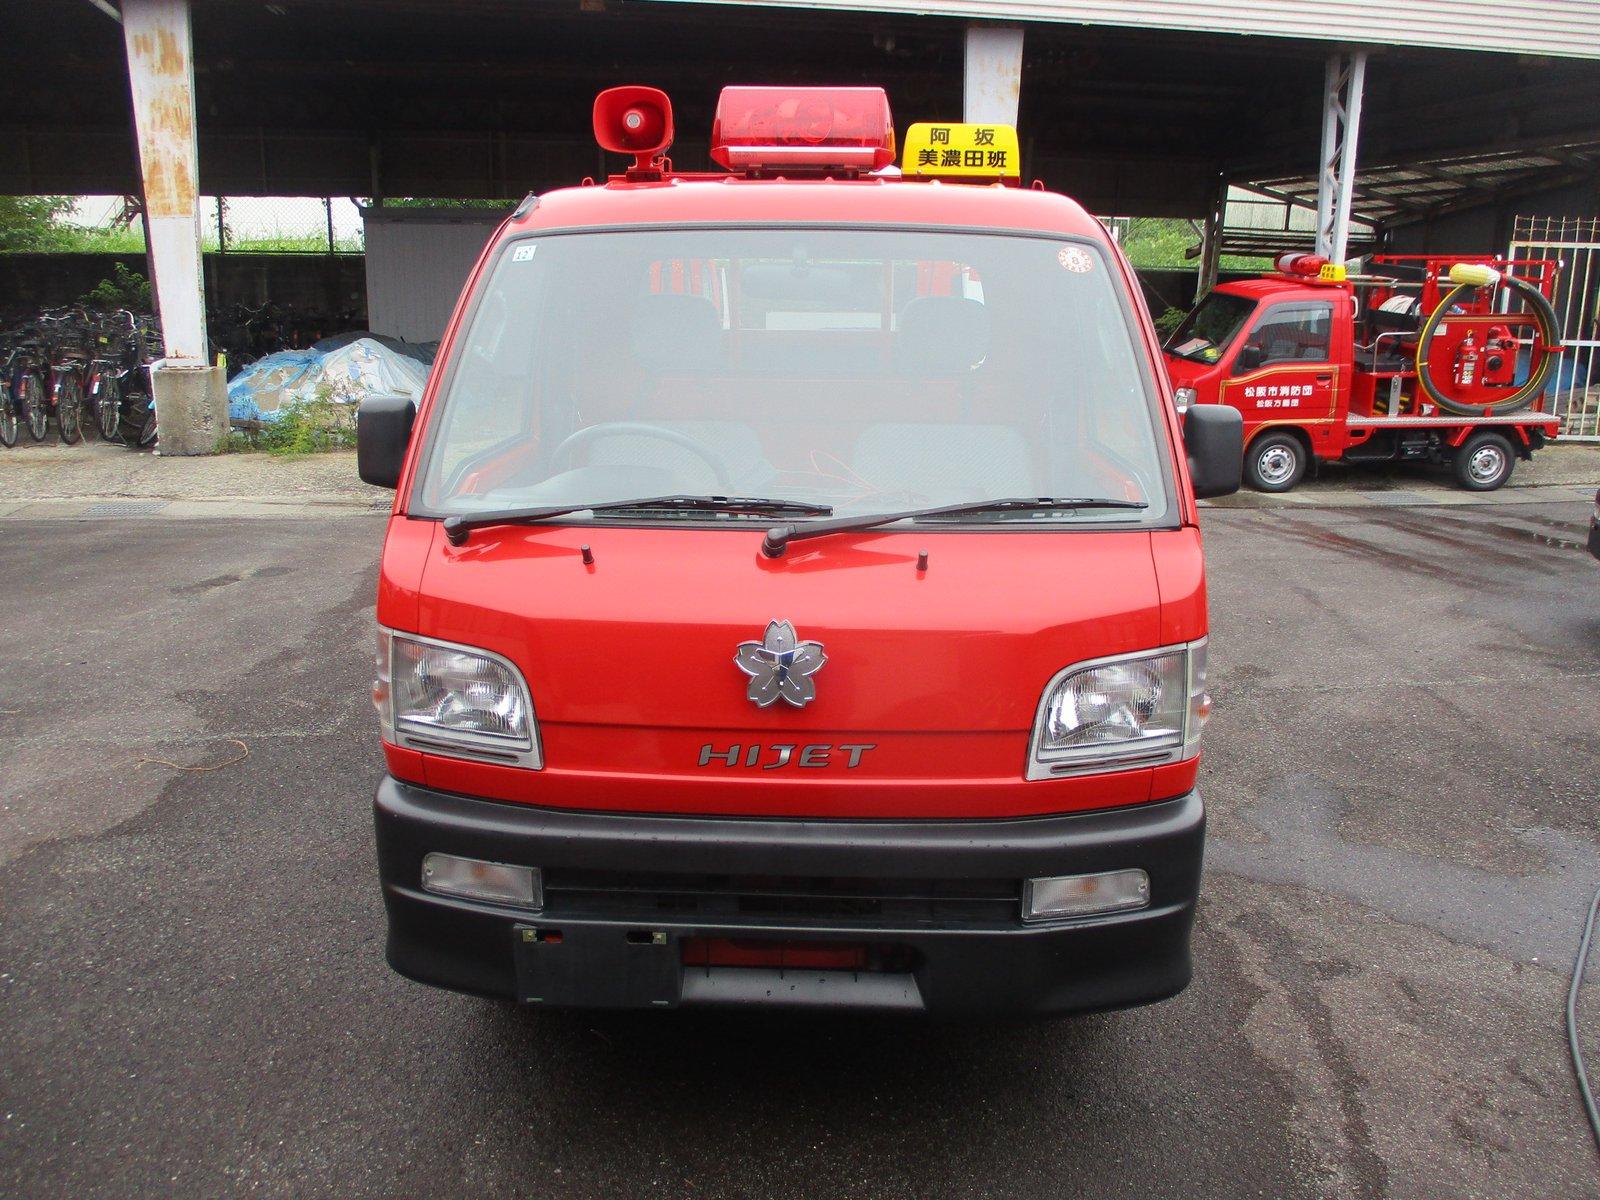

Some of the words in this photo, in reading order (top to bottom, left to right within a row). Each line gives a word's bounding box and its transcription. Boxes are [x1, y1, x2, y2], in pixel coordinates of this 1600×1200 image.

[918, 149, 1007, 168] 美濃田班
[698, 743, 877, 769] HIJET
